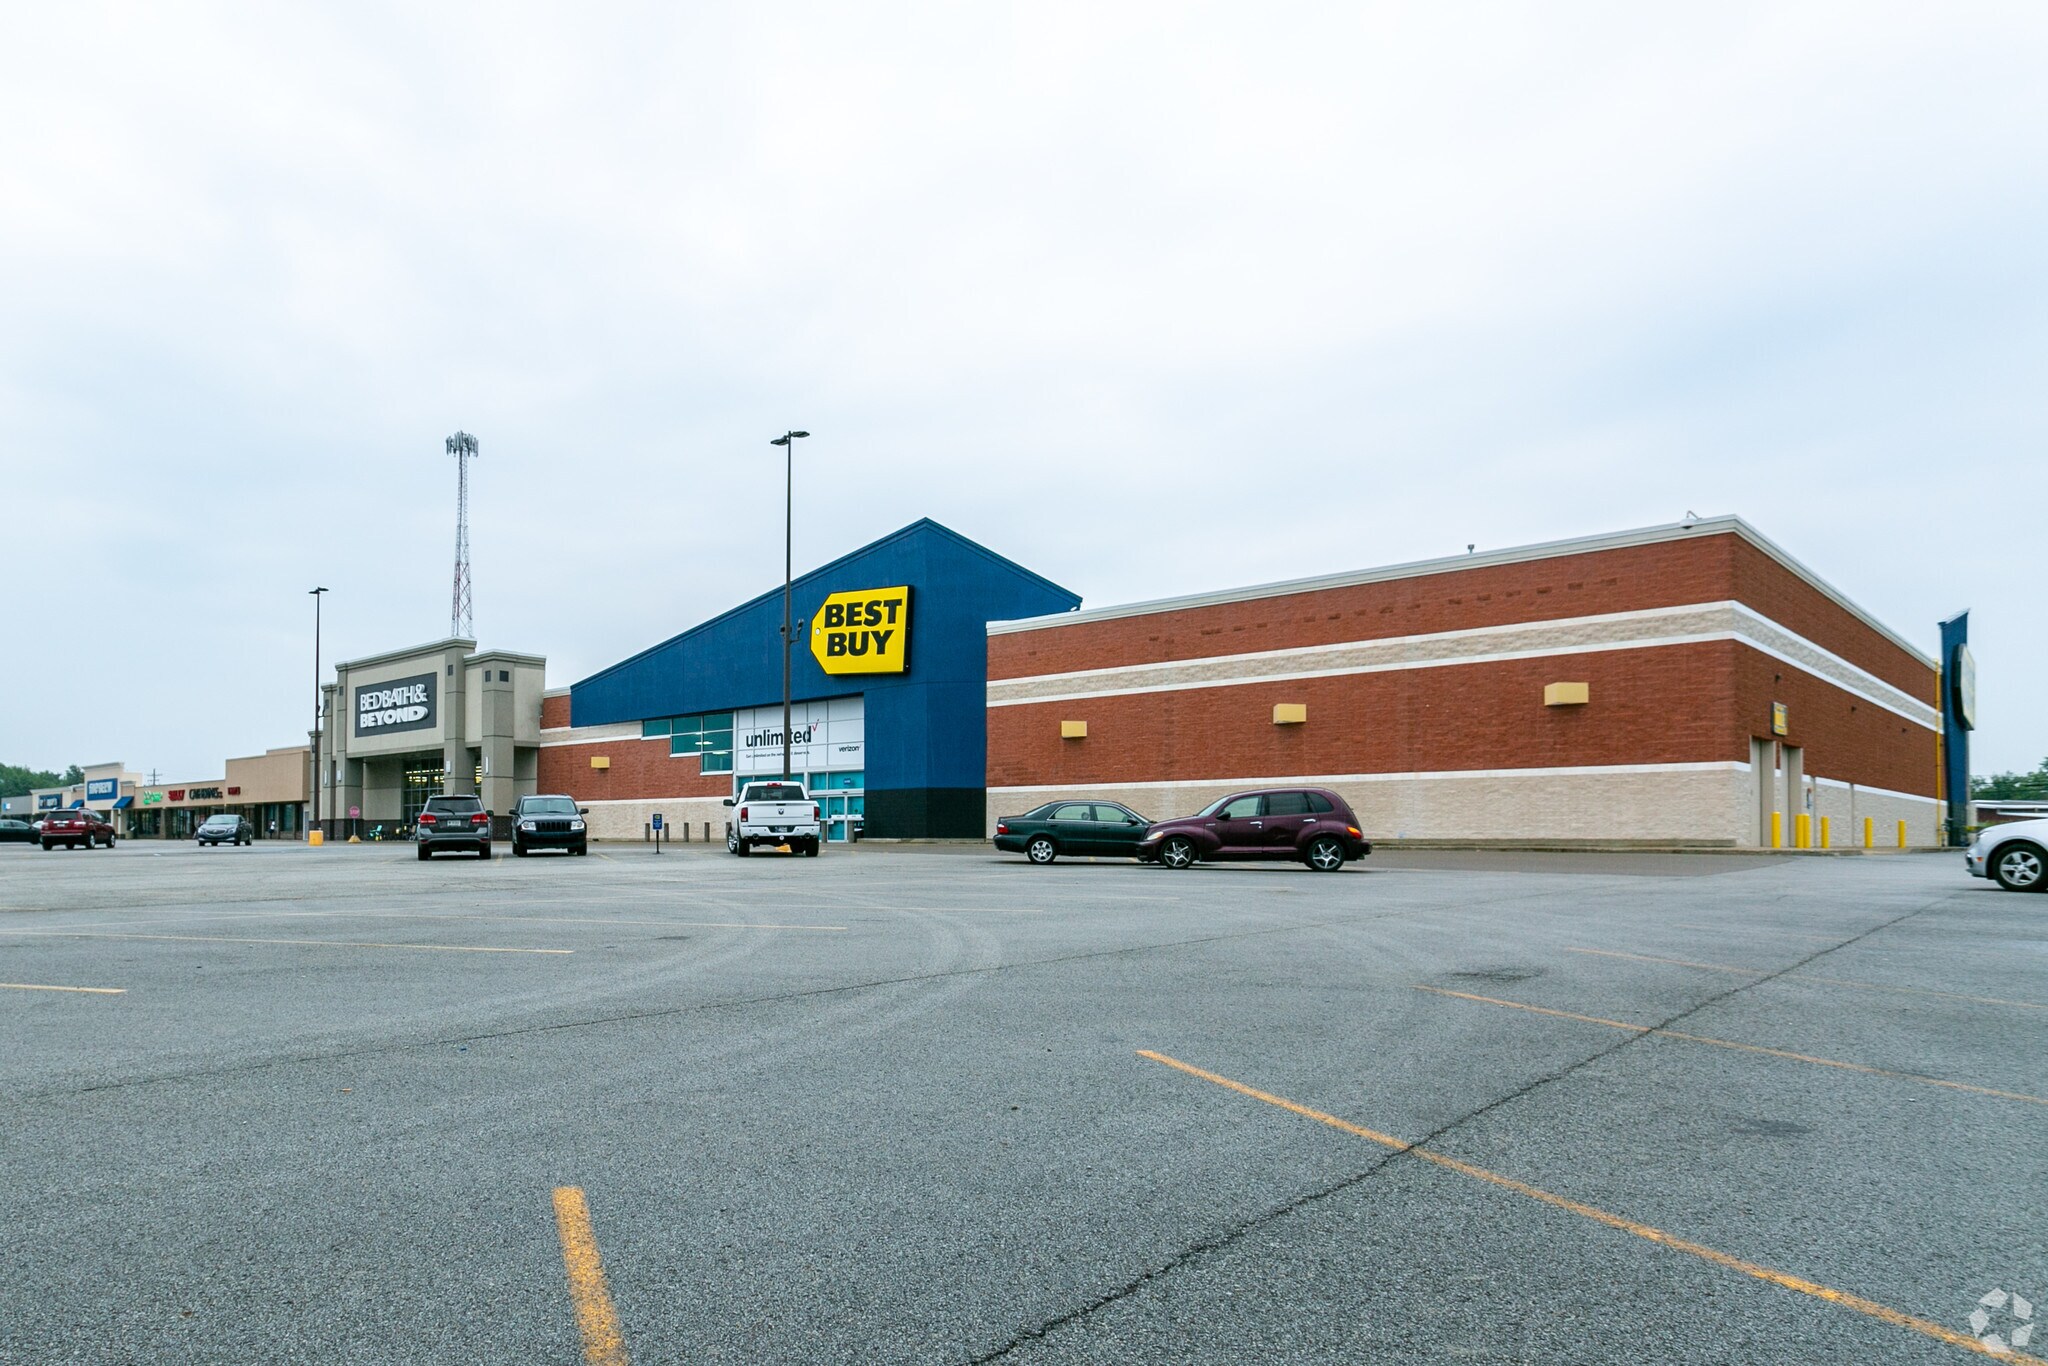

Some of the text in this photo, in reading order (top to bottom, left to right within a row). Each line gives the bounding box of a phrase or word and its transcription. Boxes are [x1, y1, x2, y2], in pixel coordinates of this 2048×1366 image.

[824, 598, 903, 628] BEST
[827, 629, 895, 657] BUY
[360, 683, 428, 711] BED BATH &
[360, 705, 428, 728] BEYOND
[746, 725, 812, 748] unlimted
